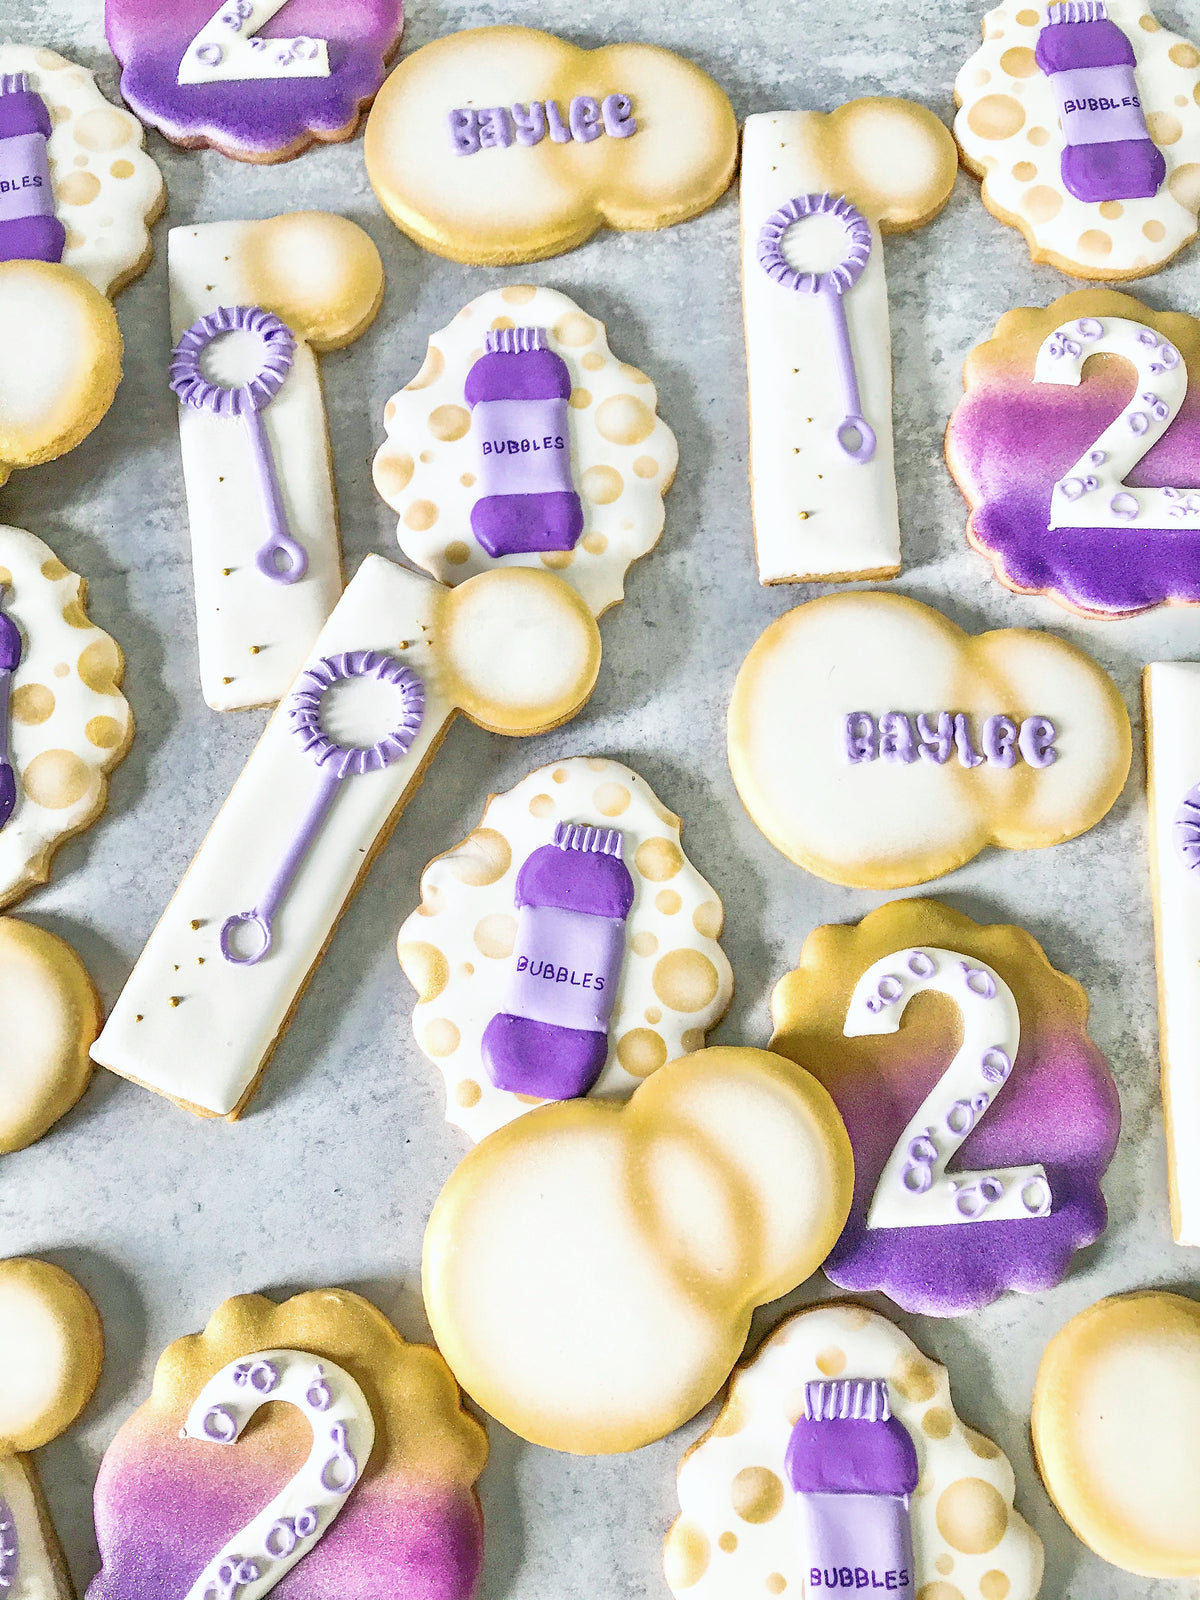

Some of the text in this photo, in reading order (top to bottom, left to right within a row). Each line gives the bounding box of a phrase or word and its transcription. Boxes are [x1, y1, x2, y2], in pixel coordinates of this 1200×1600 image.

[1064, 97, 1141, 113] BUBBLES
[1034, 316, 1200, 530] 2
[483, 436, 565, 456] BUBBLES
[517, 956, 606, 991] BUBBLES
[843, 946, 1052, 1229] 2
[811, 1566, 909, 1589] BUBBLES
